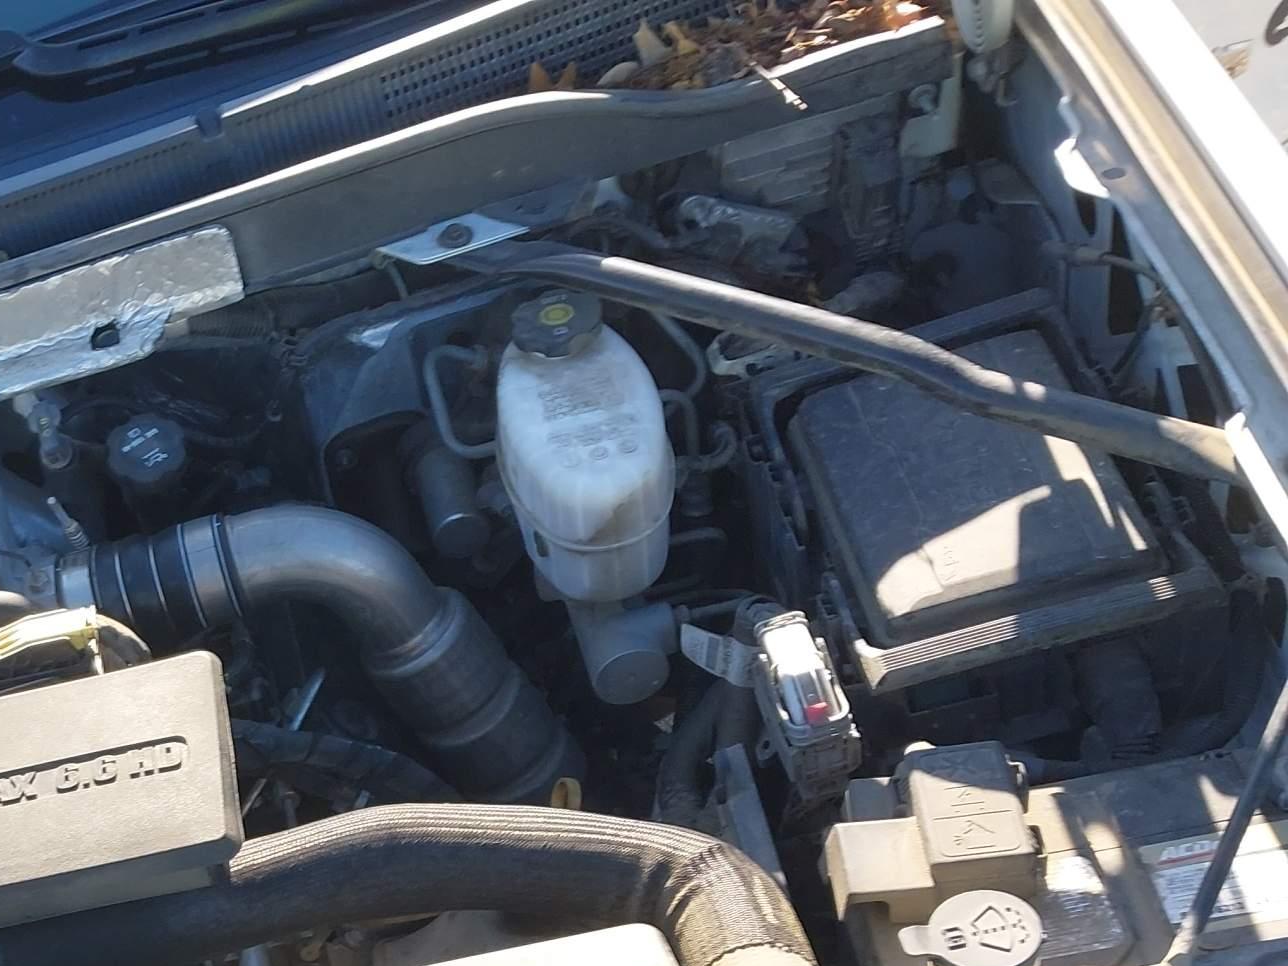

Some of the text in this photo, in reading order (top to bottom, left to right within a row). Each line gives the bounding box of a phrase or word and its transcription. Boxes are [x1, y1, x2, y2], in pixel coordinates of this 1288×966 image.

[55, 757, 120, 794] 6.6
[127, 741, 187, 781] HD
[1160, 840, 1220, 862] ACD
